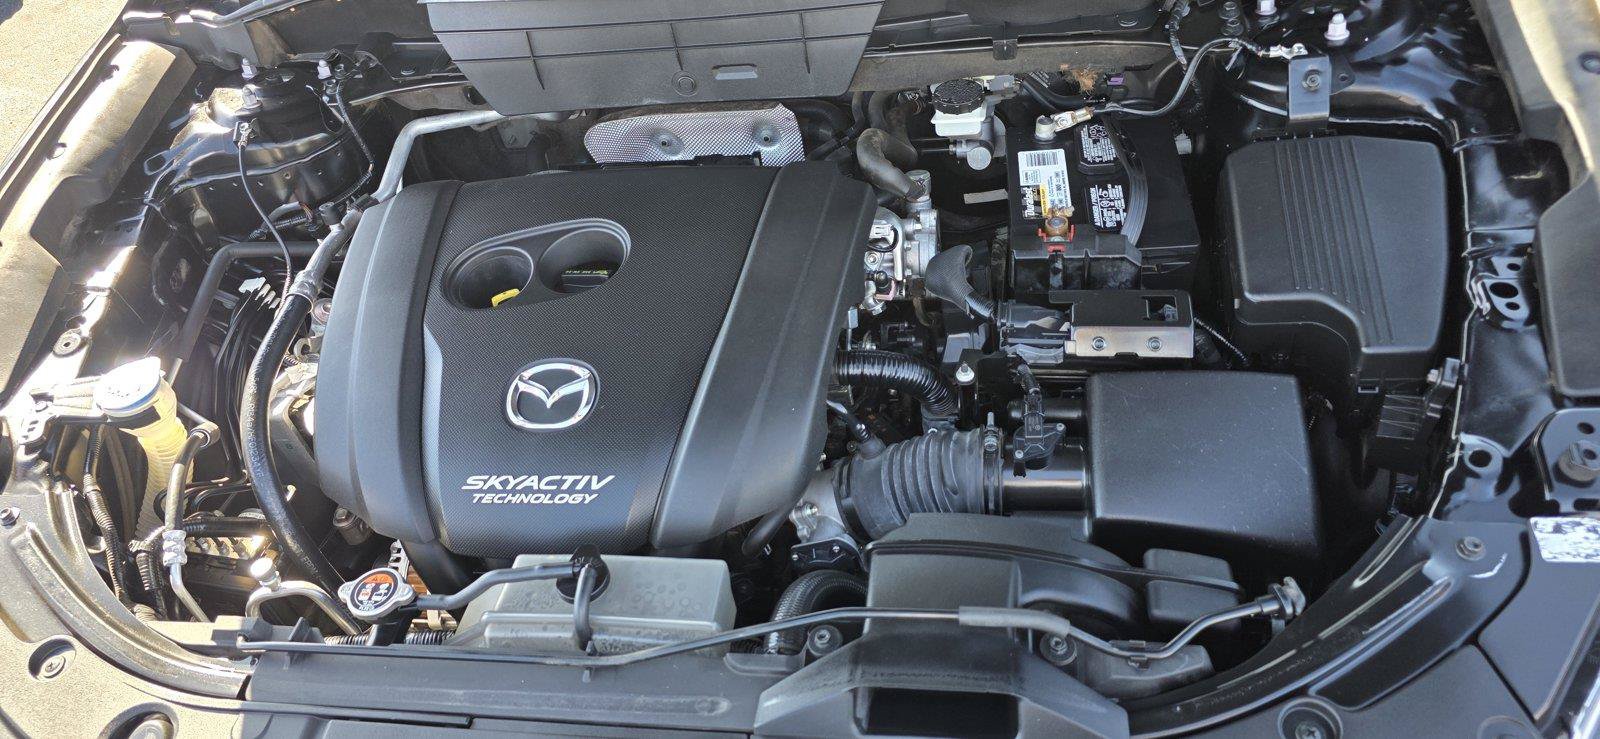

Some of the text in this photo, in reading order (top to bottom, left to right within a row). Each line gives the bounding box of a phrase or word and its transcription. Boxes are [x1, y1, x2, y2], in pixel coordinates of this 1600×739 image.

[1022, 187, 1035, 218] Duralast
[461, 475, 615, 490] SKYACTIV
[472, 493, 599, 504] TECHNOLOGY
